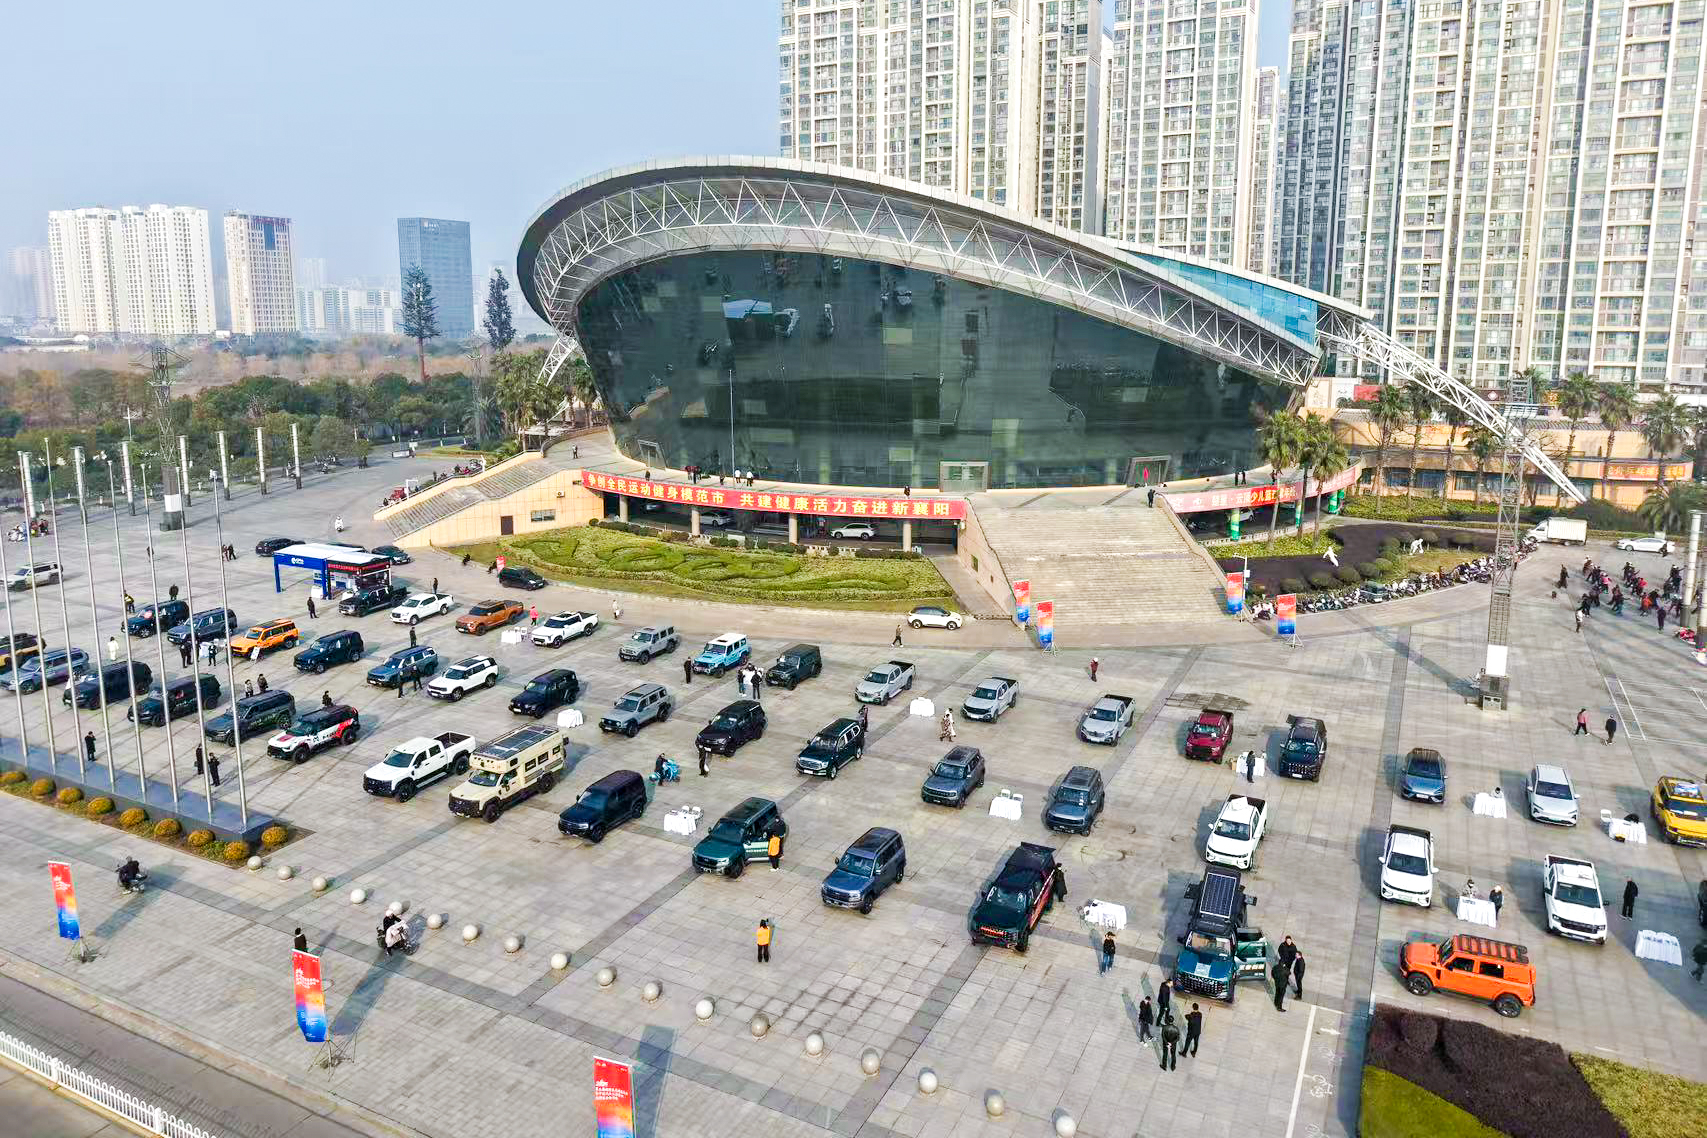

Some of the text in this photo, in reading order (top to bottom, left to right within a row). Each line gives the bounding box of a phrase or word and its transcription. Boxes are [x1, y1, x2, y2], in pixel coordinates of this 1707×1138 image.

[588, 473, 950, 516] 争创全民运动健身模范市 共建健康活力奋进新襄阳
